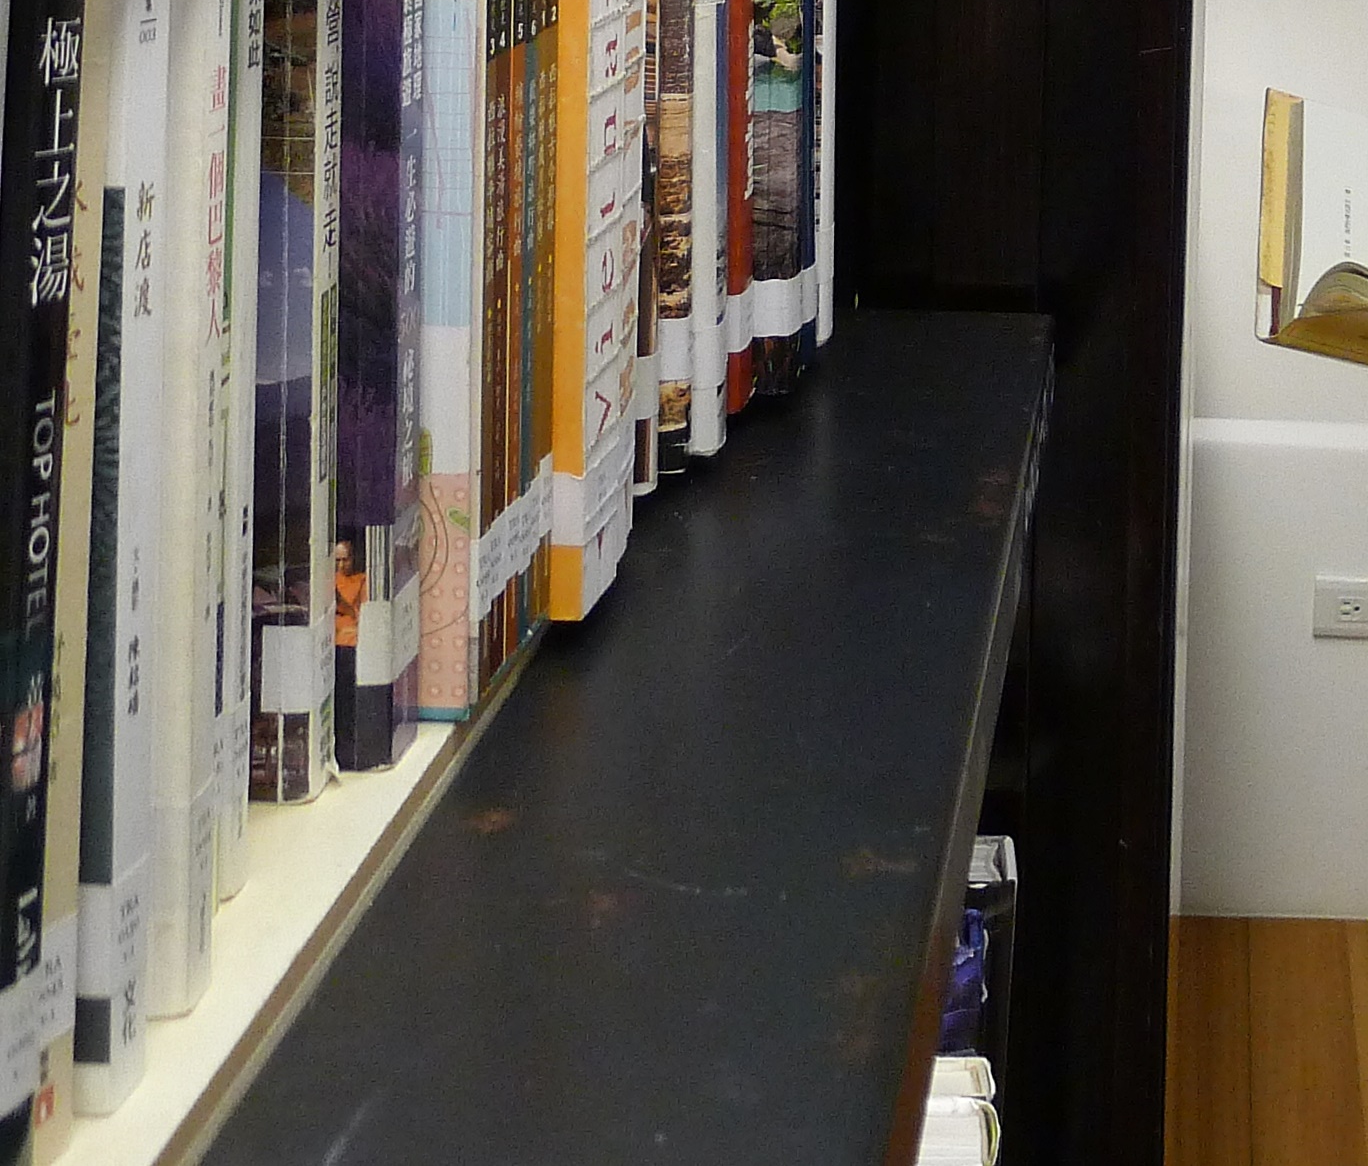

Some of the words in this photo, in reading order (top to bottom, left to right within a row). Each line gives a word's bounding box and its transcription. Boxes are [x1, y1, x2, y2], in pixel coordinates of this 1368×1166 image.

[517, 22, 524, 40] 5
[550, 5, 557, 22] 2
[30, 16, 82, 308] 極上之湯
[205, 63, 228, 345] 畫一個巴黎人
[133, 180, 156, 318] 新店渡
[31, 388, 57, 481] TOP
[22, 491, 52, 639] HOTEL
